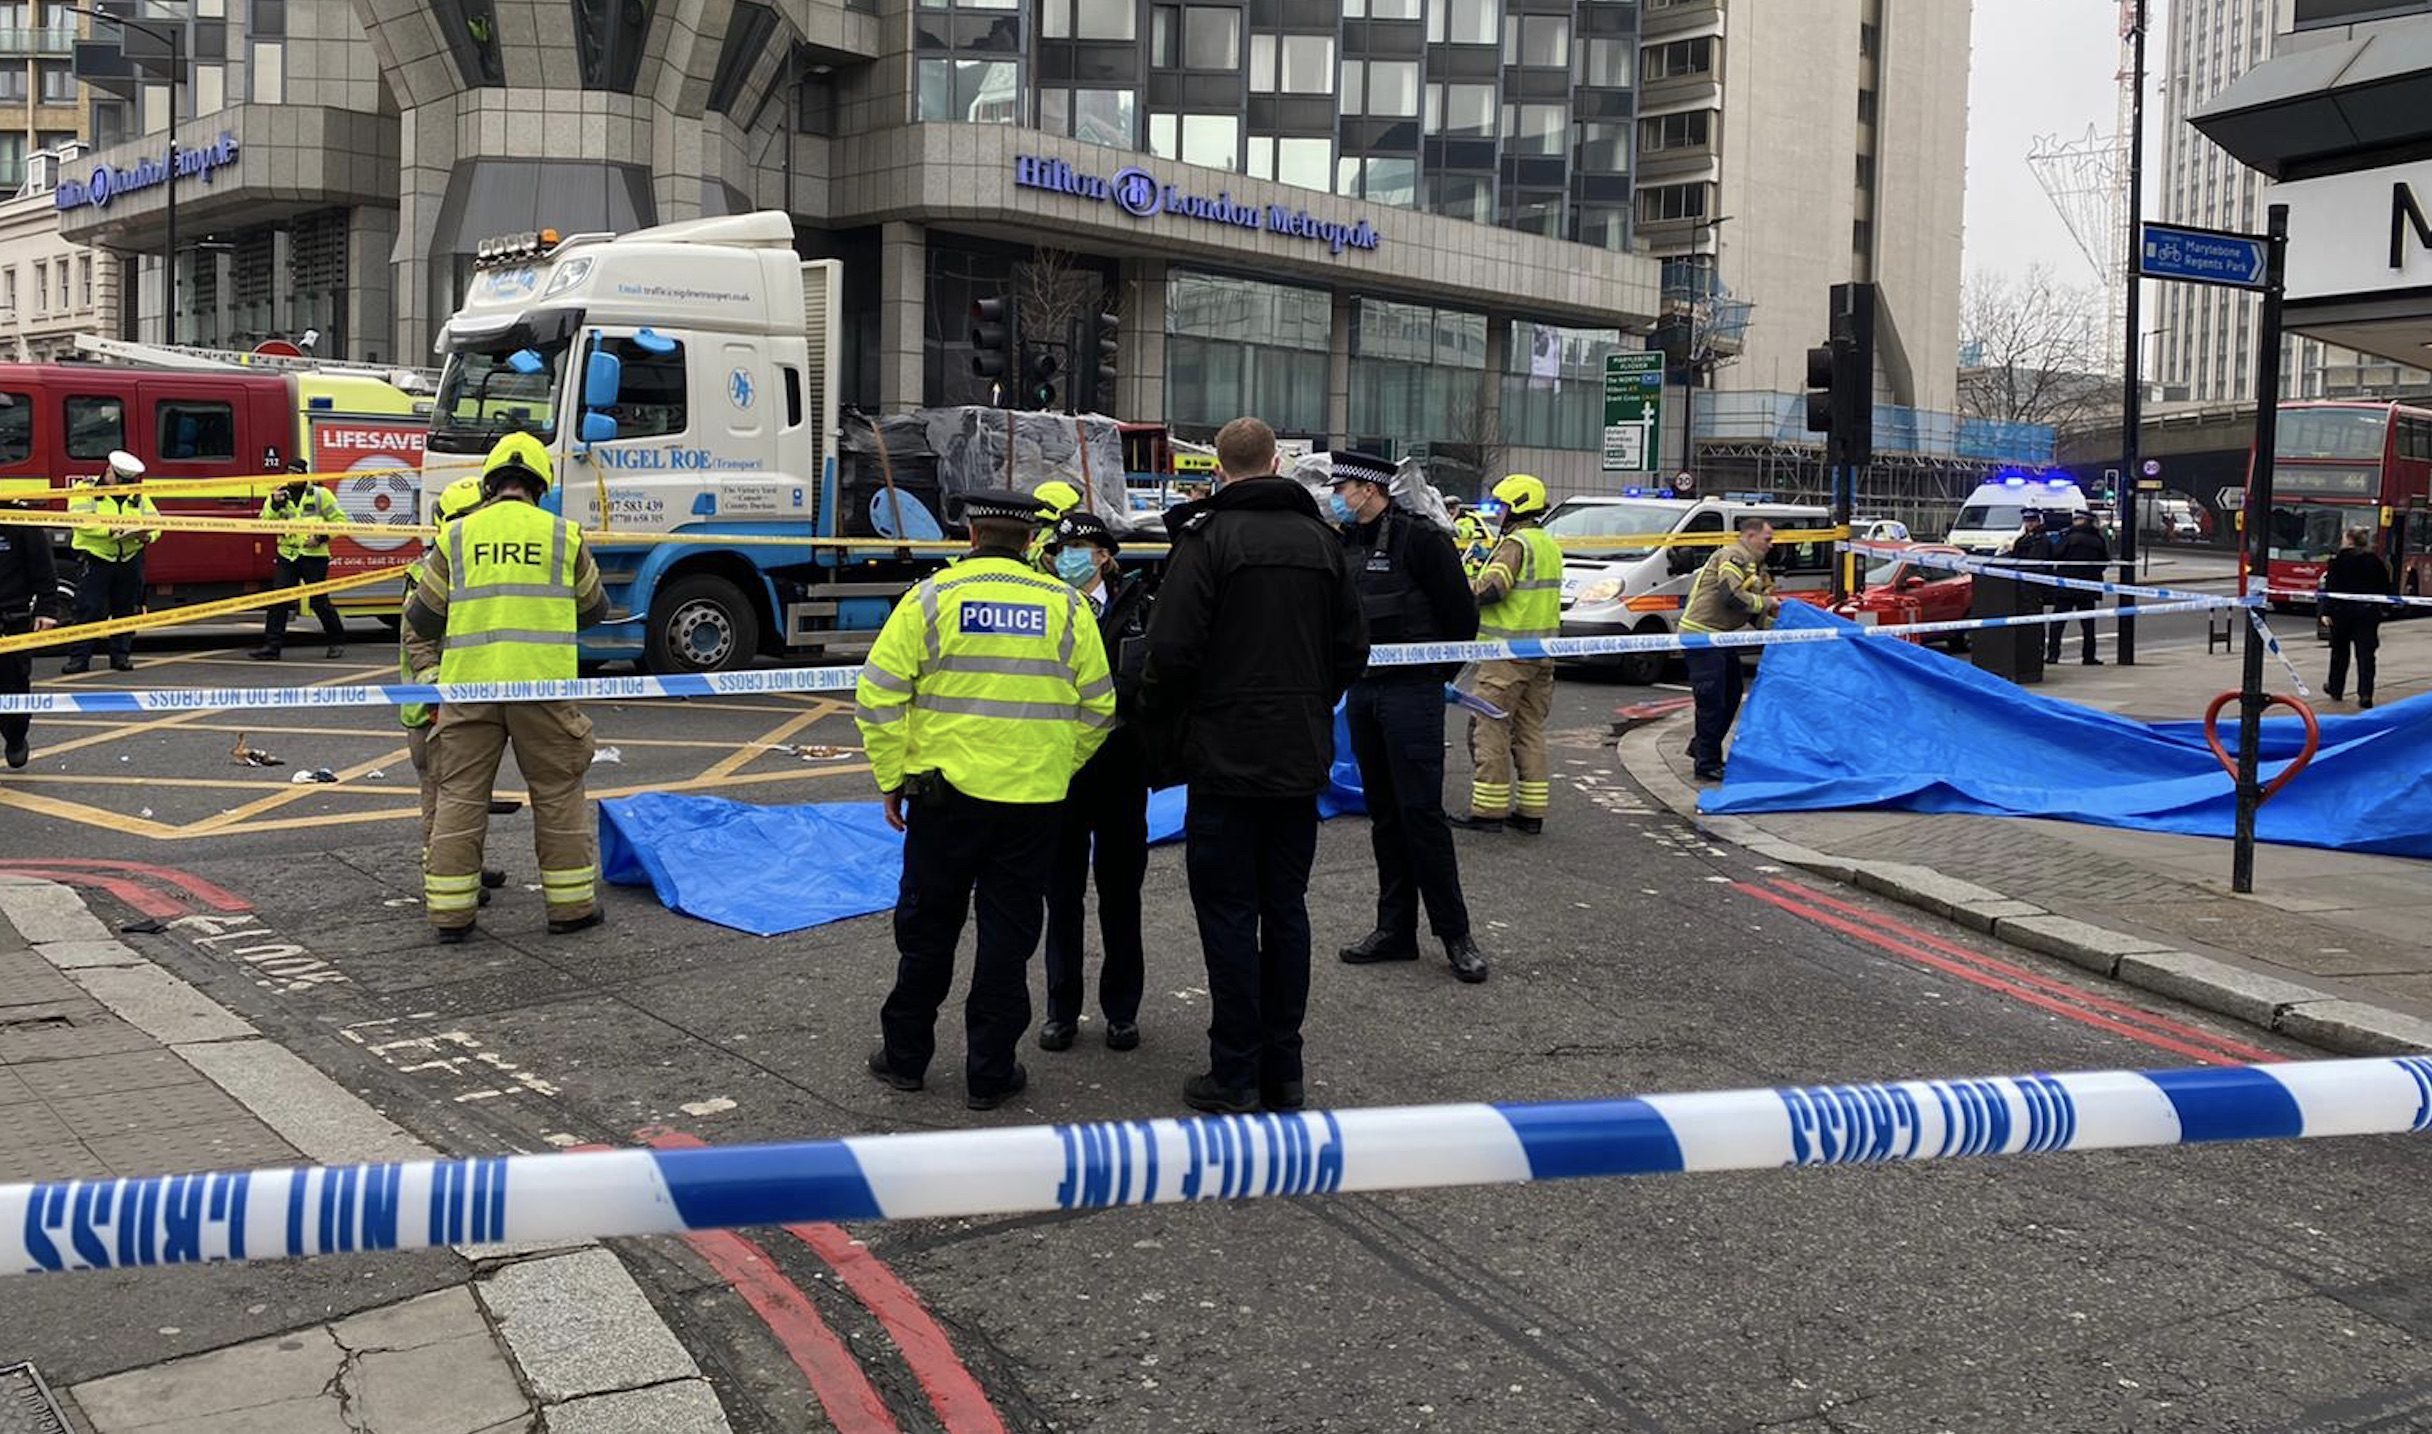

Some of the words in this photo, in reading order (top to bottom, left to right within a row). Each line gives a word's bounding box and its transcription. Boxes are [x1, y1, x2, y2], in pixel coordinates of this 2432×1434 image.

[1015, 155, 1111, 200] Hilton
[1163, 185, 1263, 228] London
[1265, 203, 1381, 254] Metropole
[2185, 240, 2241, 258] Marylebone
[2184, 254, 2223, 270] Regents
[2226, 260, 2247, 272] Park
[599, 449, 666, 470] NIGEL
[671, 449, 711, 470] ROE
[588, 500, 621, 512] 0107
[474, 543, 542, 566] FIRE
[962, 606, 1043, 631] POLICE
[560, 679, 591, 697] LINE
[596, 677, 644, 696] POLICE
[719, 673, 763, 693] CROSS
[769, 671, 792, 690] NOT
[796, 670, 816, 689] DO
[819, 669, 847, 688] LINE
[149, 689, 201, 708] CROSS
[208, 688, 241, 706] NOT
[246, 688, 268, 705] DO
[273, 687, 309, 704] LINE
[313, 685, 367, 702] POLICE
[449, 683, 498, 701] CROSS
[503, 682, 531, 699] NOT
[536, 680, 556, 698] DO
[0, 693, 53, 710] POLIC
[1774, 1081, 1924, 1168] CROSS
[1053, 1118, 1159, 1210] LINE
[1177, 1109, 1345, 1201] POLICE
[23, 1170, 253, 1274] CROSS
